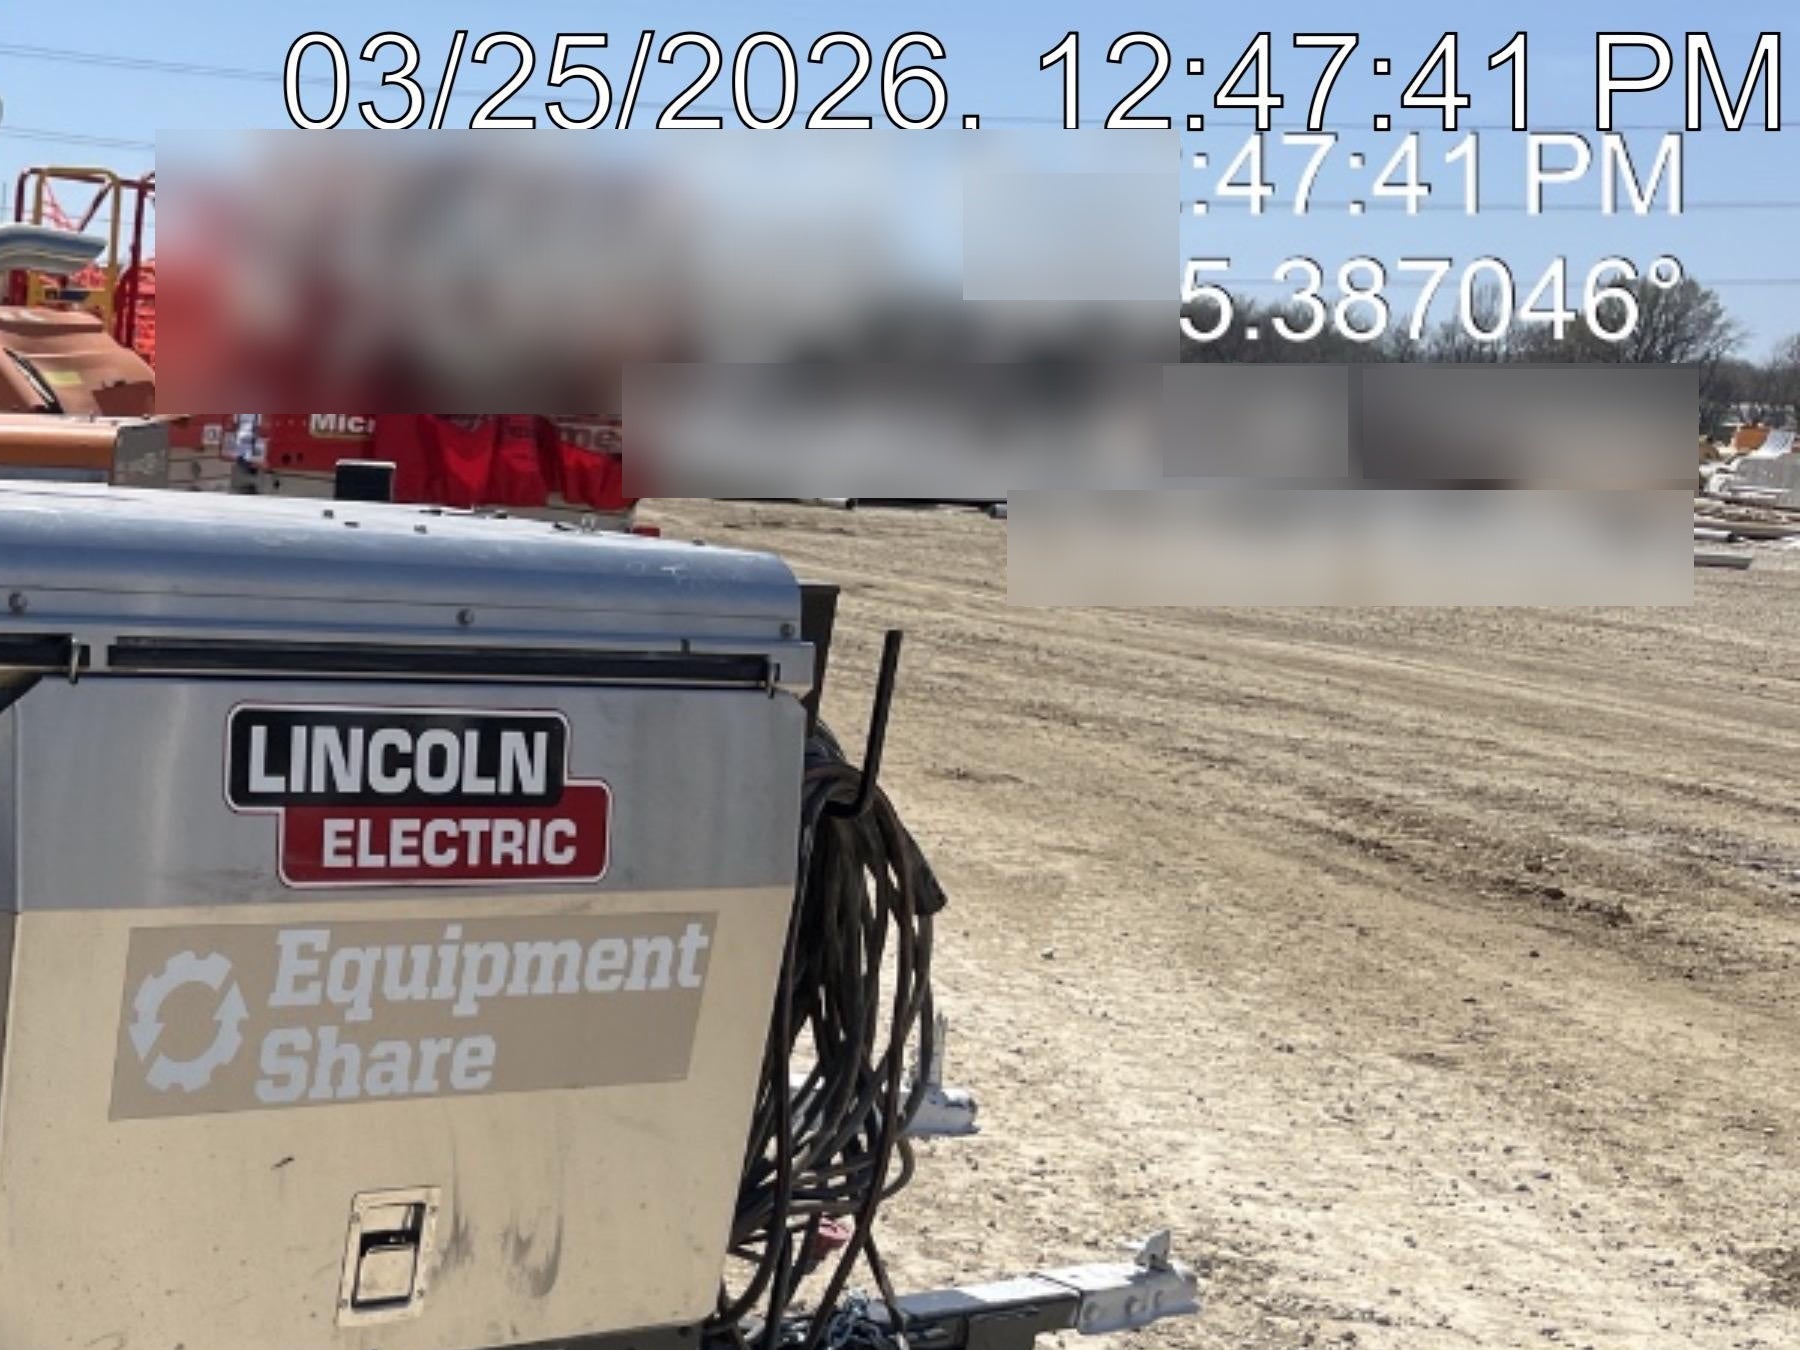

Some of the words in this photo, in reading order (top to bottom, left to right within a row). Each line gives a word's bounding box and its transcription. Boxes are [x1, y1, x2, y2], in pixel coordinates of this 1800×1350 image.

[248, 724, 550, 796] LINCOLN
[322, 818, 578, 869] ELECTRIC
[270, 923, 710, 1023] Equipment
[255, 1025, 497, 1104] Share
